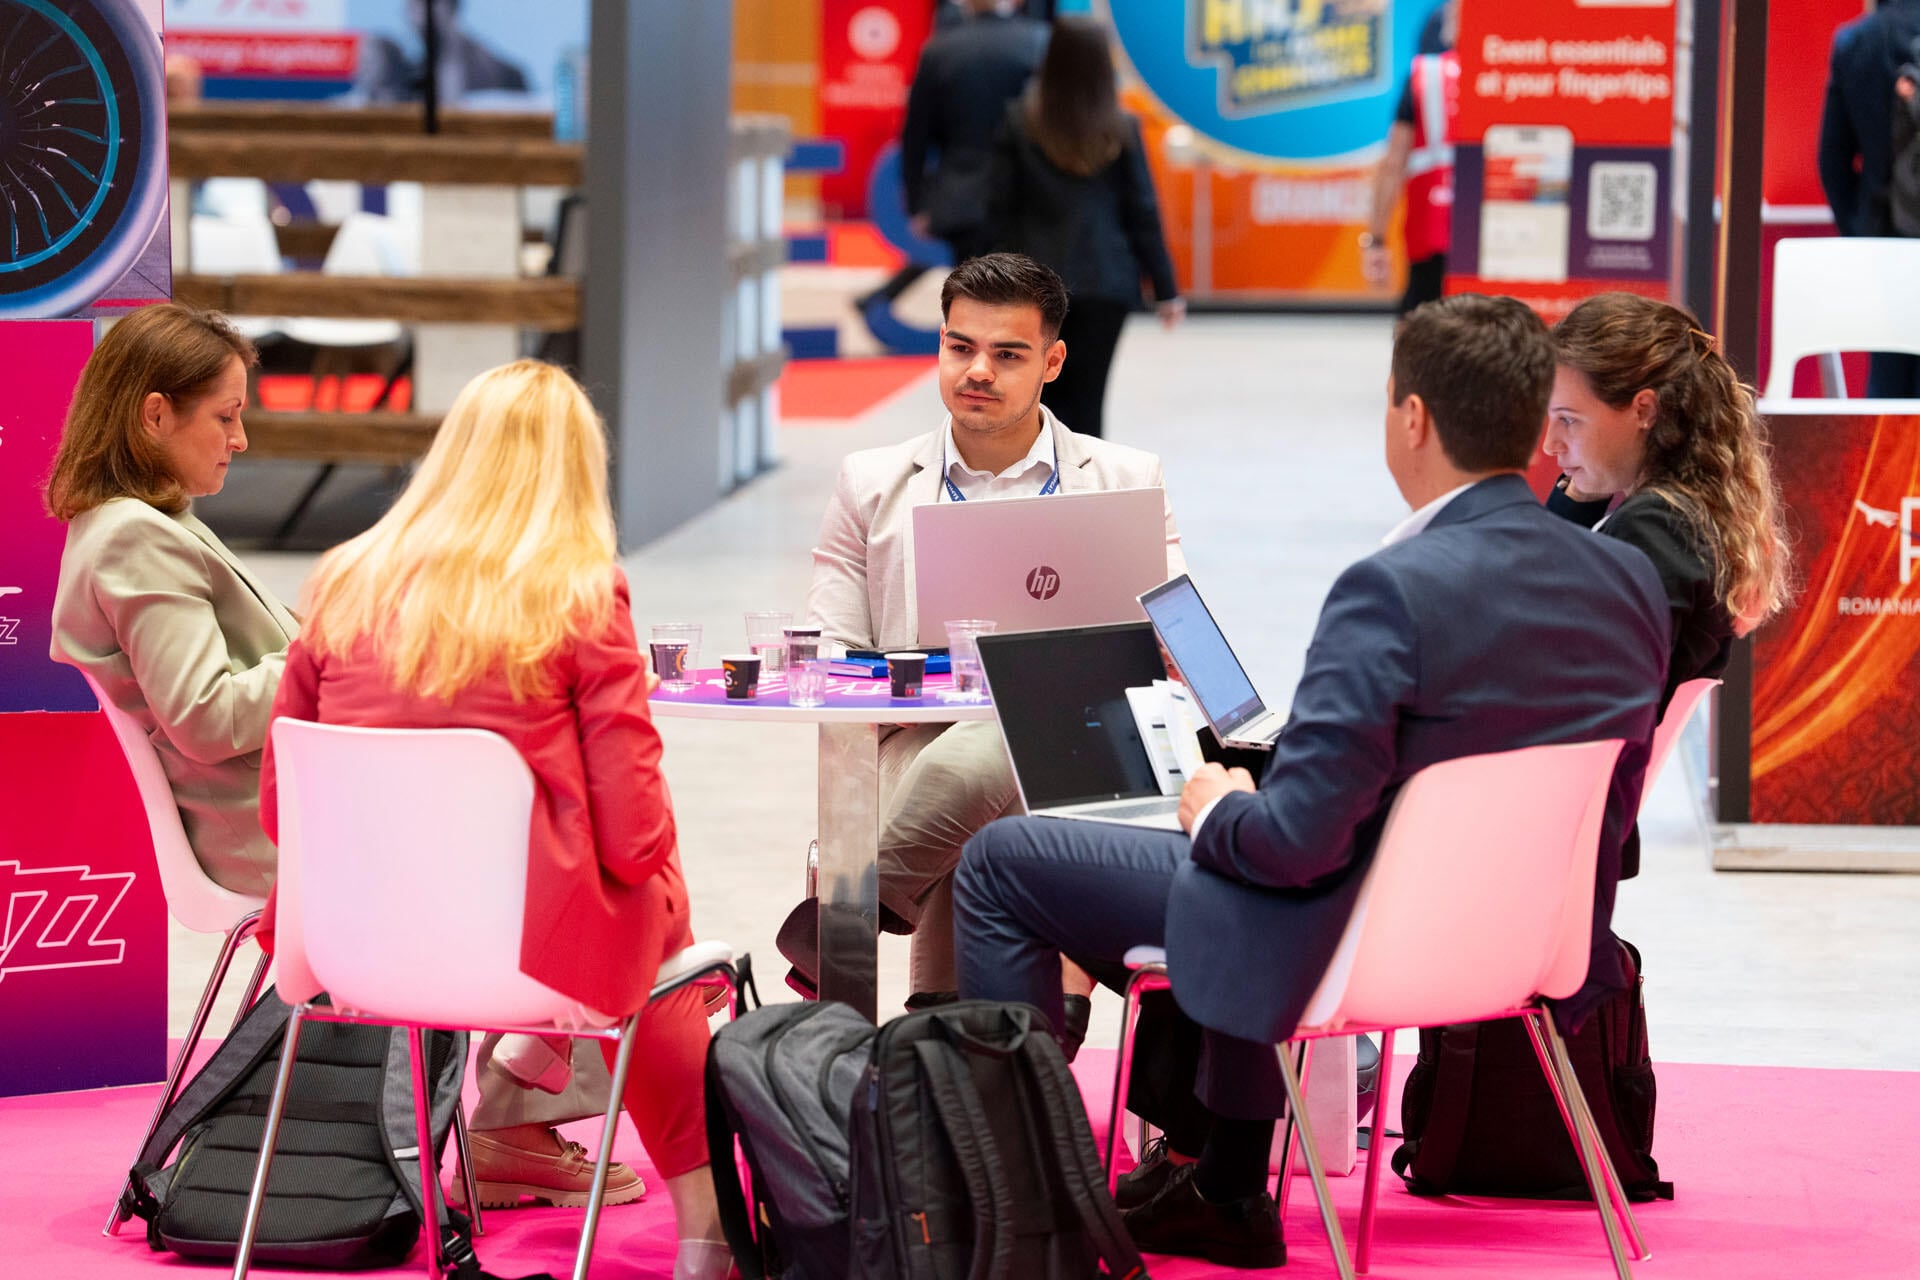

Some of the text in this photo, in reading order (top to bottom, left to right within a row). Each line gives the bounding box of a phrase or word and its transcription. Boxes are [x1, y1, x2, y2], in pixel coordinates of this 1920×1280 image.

[1484, 35, 1667, 65] Event essentials
[1476, 66, 1671, 104] at your fingertips
[1028, 566, 1058, 600] hp
